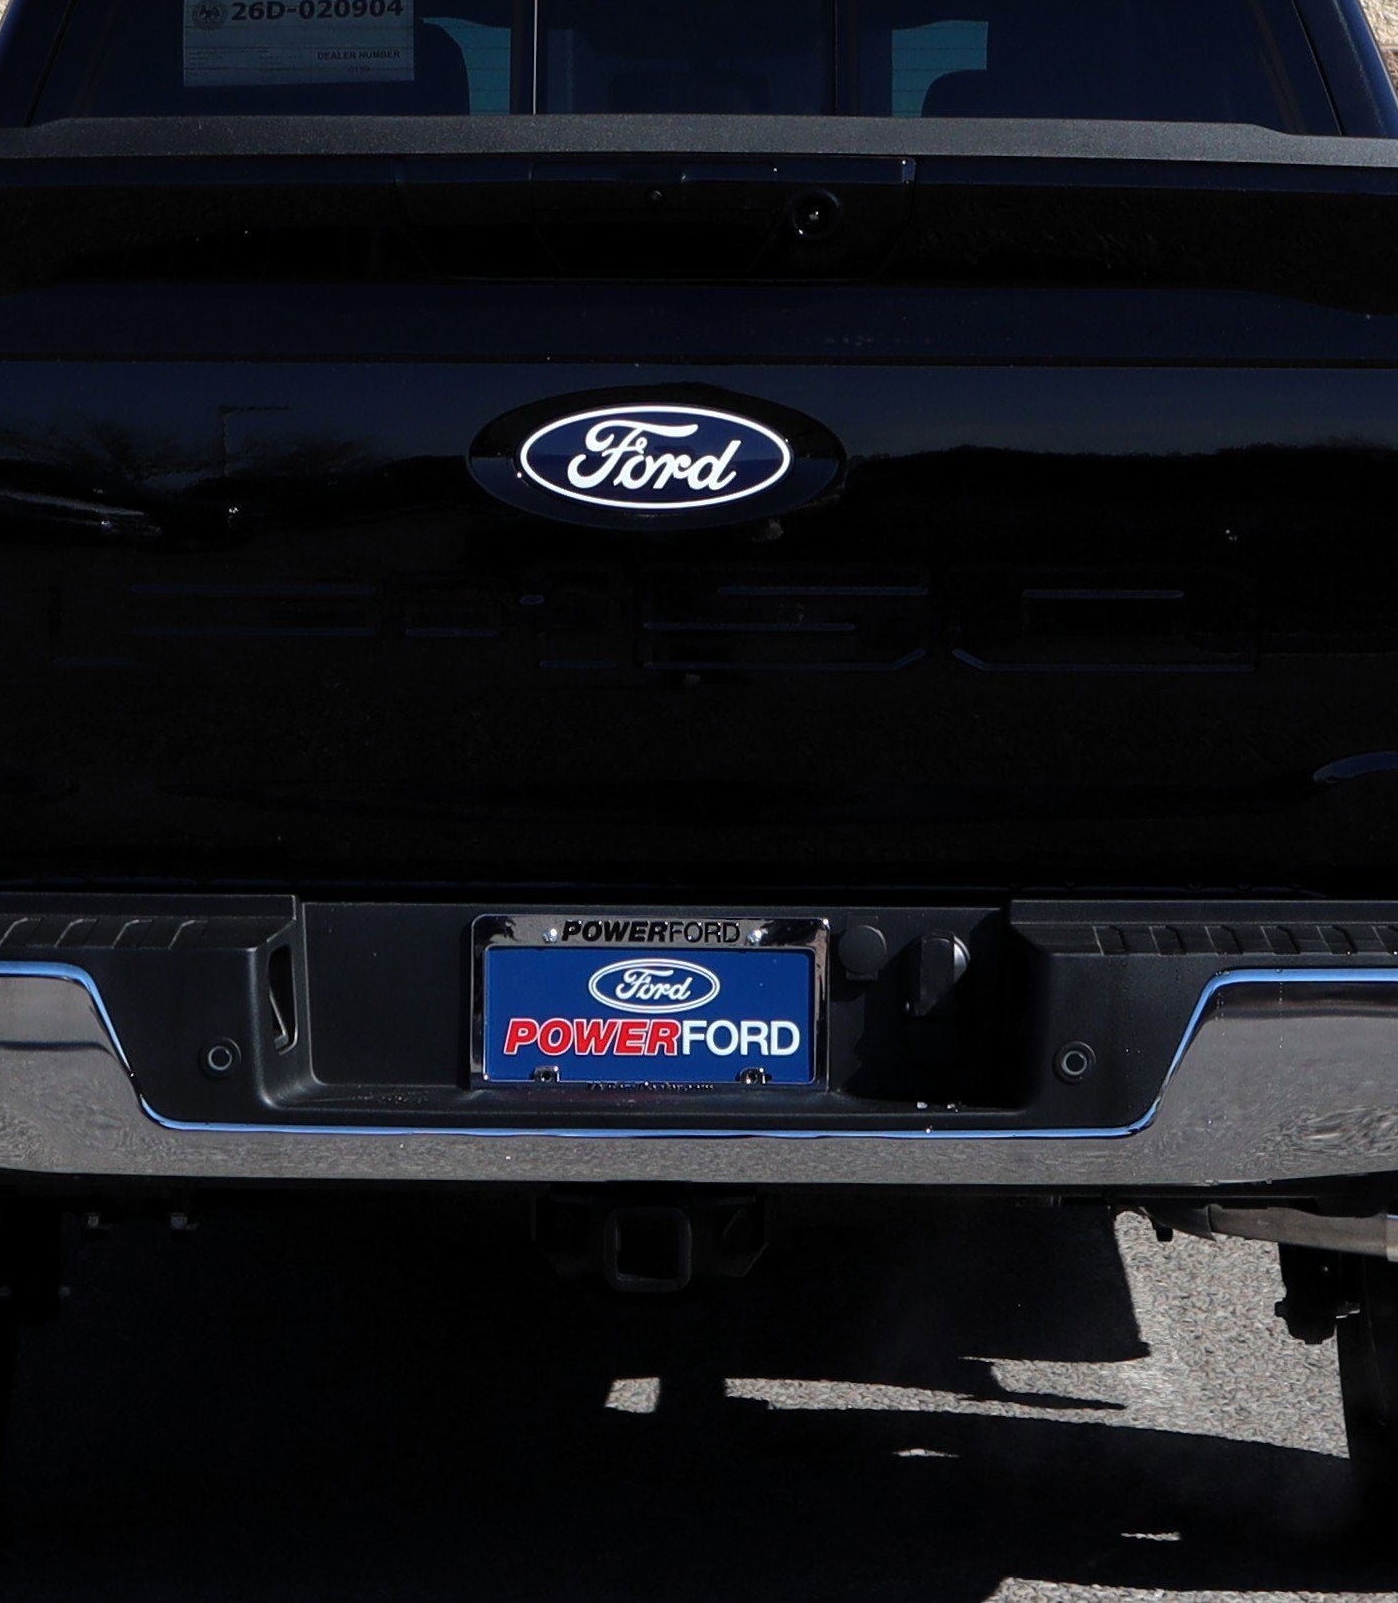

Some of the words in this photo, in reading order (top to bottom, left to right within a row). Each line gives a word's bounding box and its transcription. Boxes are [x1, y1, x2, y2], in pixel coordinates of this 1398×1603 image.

[317, 51, 356, 60] DEALER
[358, 50, 401, 60] NUMBER
[567, 420, 742, 491] Ford
[561, 920, 740, 943] POWERFORD
[615, 969, 692, 1000] Ford
[504, 1018, 800, 1056] POWERFORD
